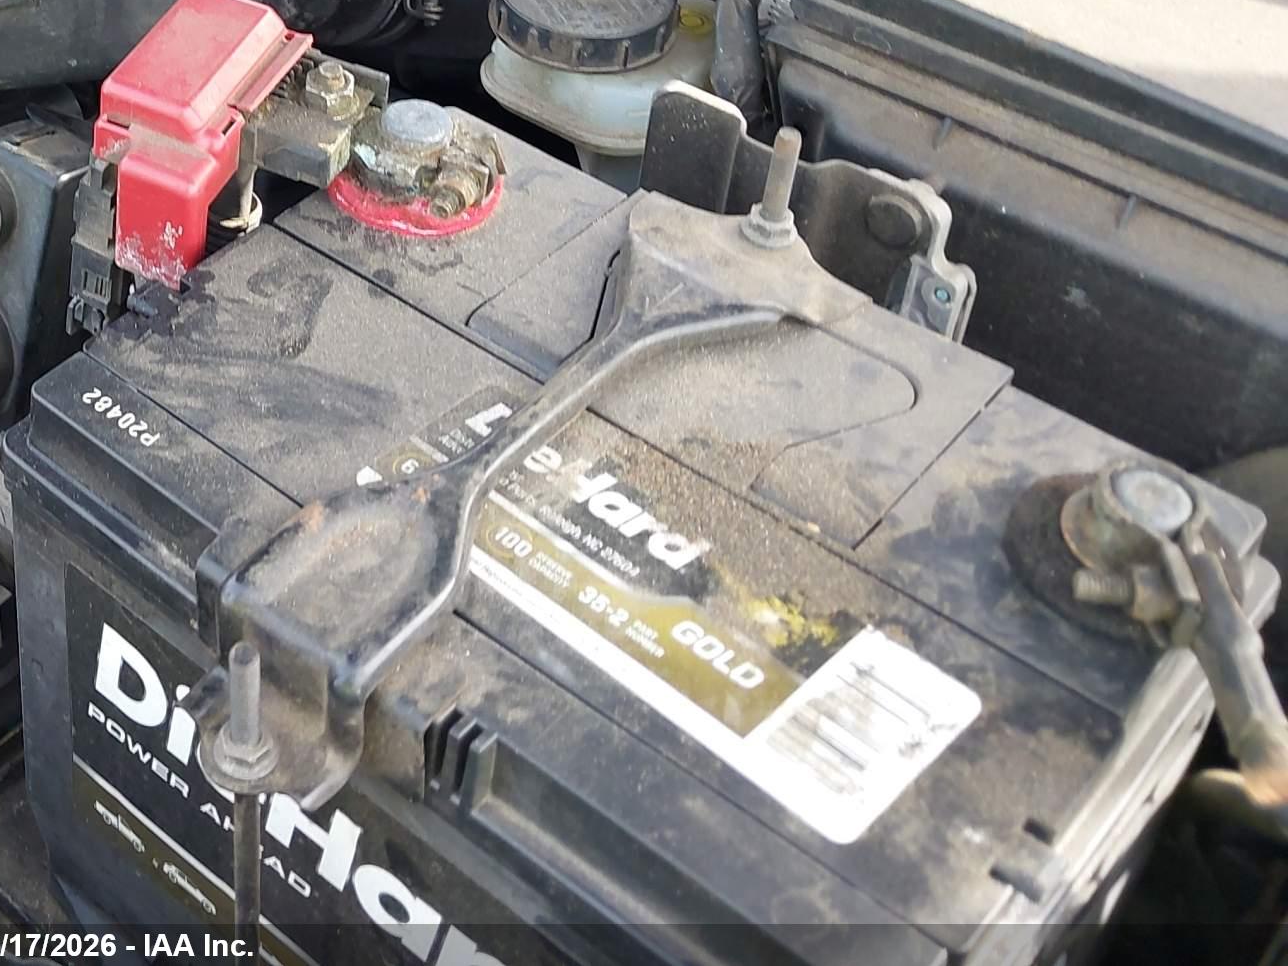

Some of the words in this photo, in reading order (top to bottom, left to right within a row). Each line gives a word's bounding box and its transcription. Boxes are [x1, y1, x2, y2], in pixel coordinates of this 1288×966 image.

[81, 386, 161, 447] P20482
[494, 526, 533, 558] 100
[671, 620, 765, 690] GOLD
[88, 701, 192, 799] POWER
